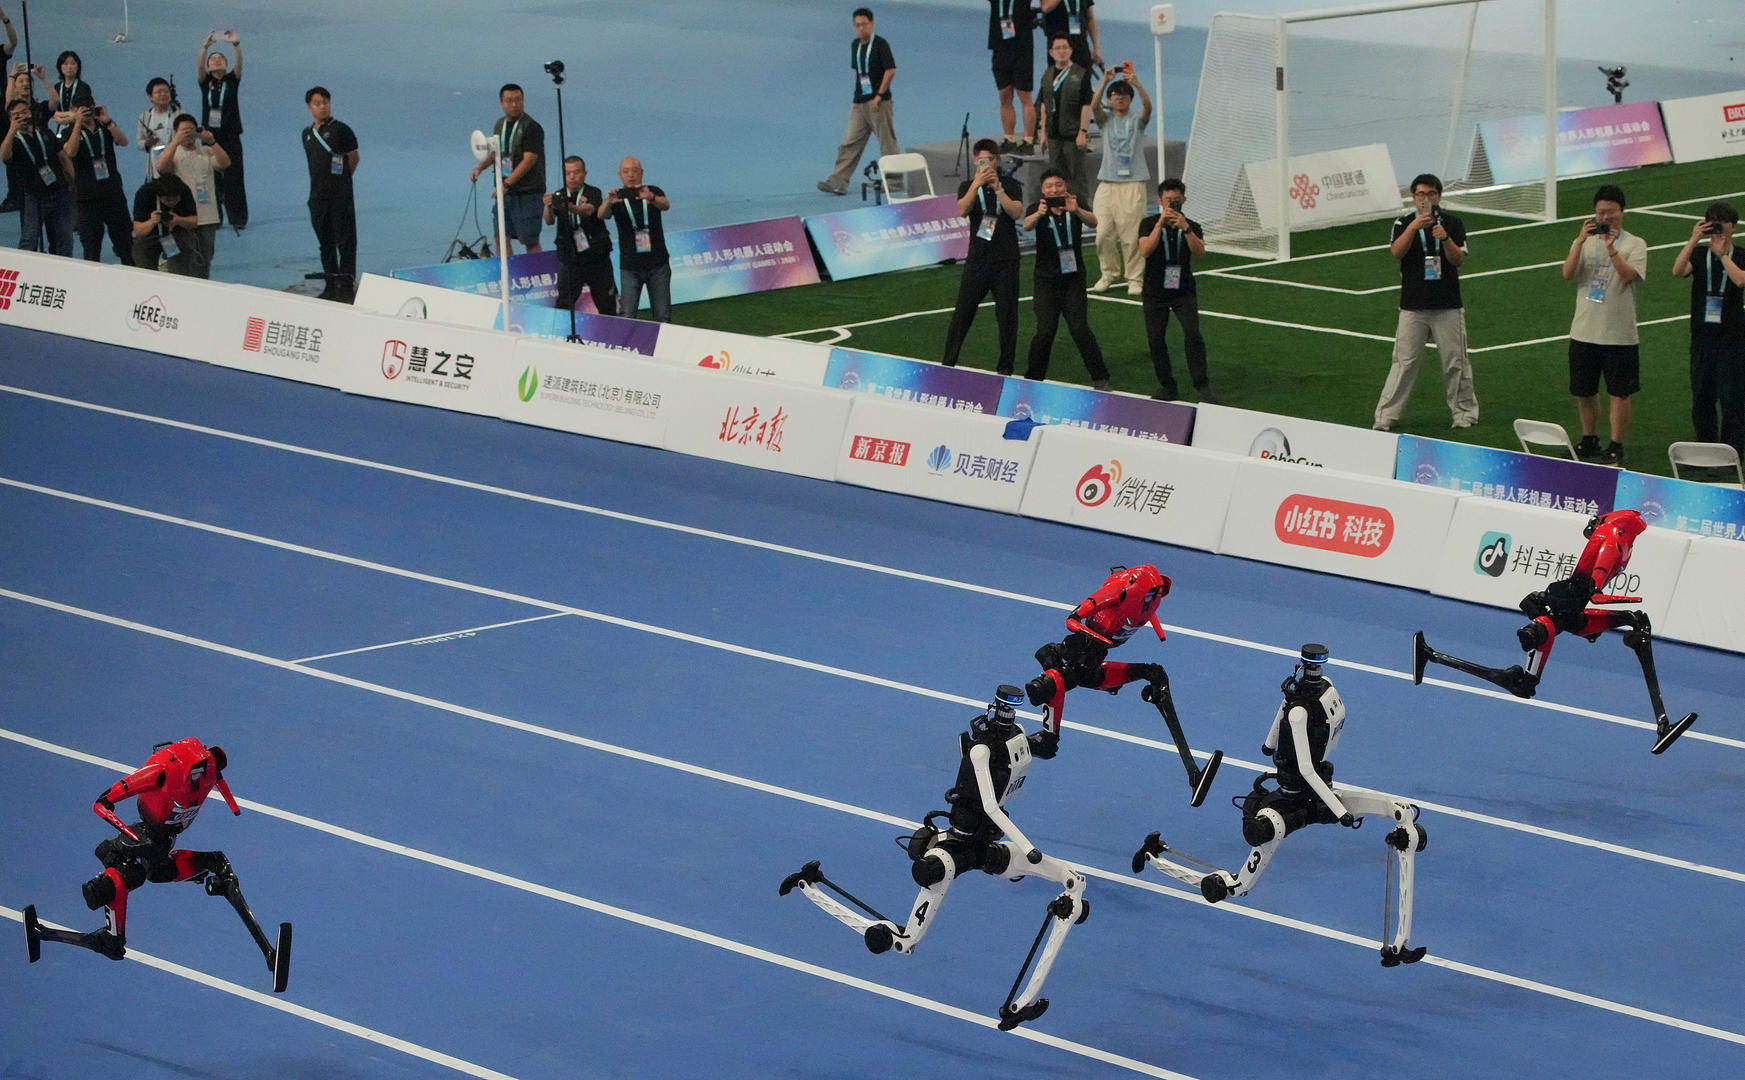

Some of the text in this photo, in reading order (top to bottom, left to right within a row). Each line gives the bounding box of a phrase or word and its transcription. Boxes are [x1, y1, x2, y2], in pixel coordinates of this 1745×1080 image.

[16, 282, 67, 310] 北京国资
[133, 303, 161, 323] HERE
[265, 320, 324, 352] 首钢基金
[263, 345, 320, 364] SHOUGANG FUND
[407, 346, 475, 380] 慧之安
[855, 437, 907, 466] 新京报
[953, 453, 1019, 484] 贝壳财经
[1113, 476, 1175, 516] 微博
[1283, 505, 1387, 549] 小红书 科技
[1526, 649, 1536, 671] 1
[1042, 704, 1050, 731] 2
[1247, 850, 1261, 874] 3
[914, 900, 929, 927] 4
